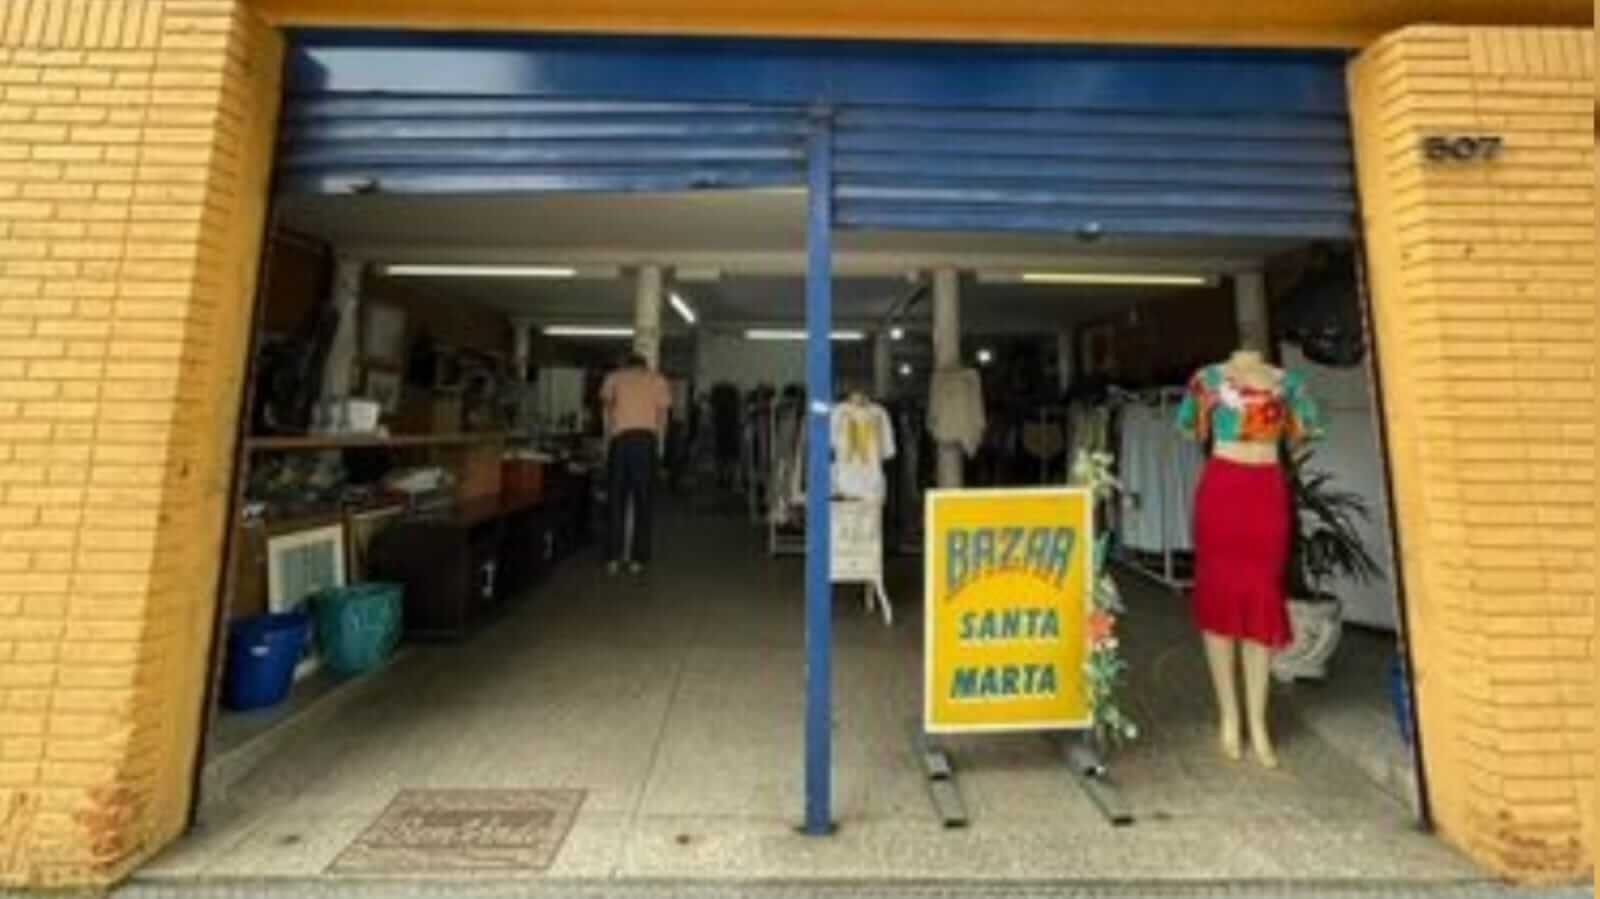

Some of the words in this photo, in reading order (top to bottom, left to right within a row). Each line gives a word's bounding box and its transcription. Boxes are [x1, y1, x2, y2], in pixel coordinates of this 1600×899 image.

[946, 526, 1076, 592] BAZAR
[959, 608, 1060, 640] SANTA
[950, 664, 1057, 699] MARTA
